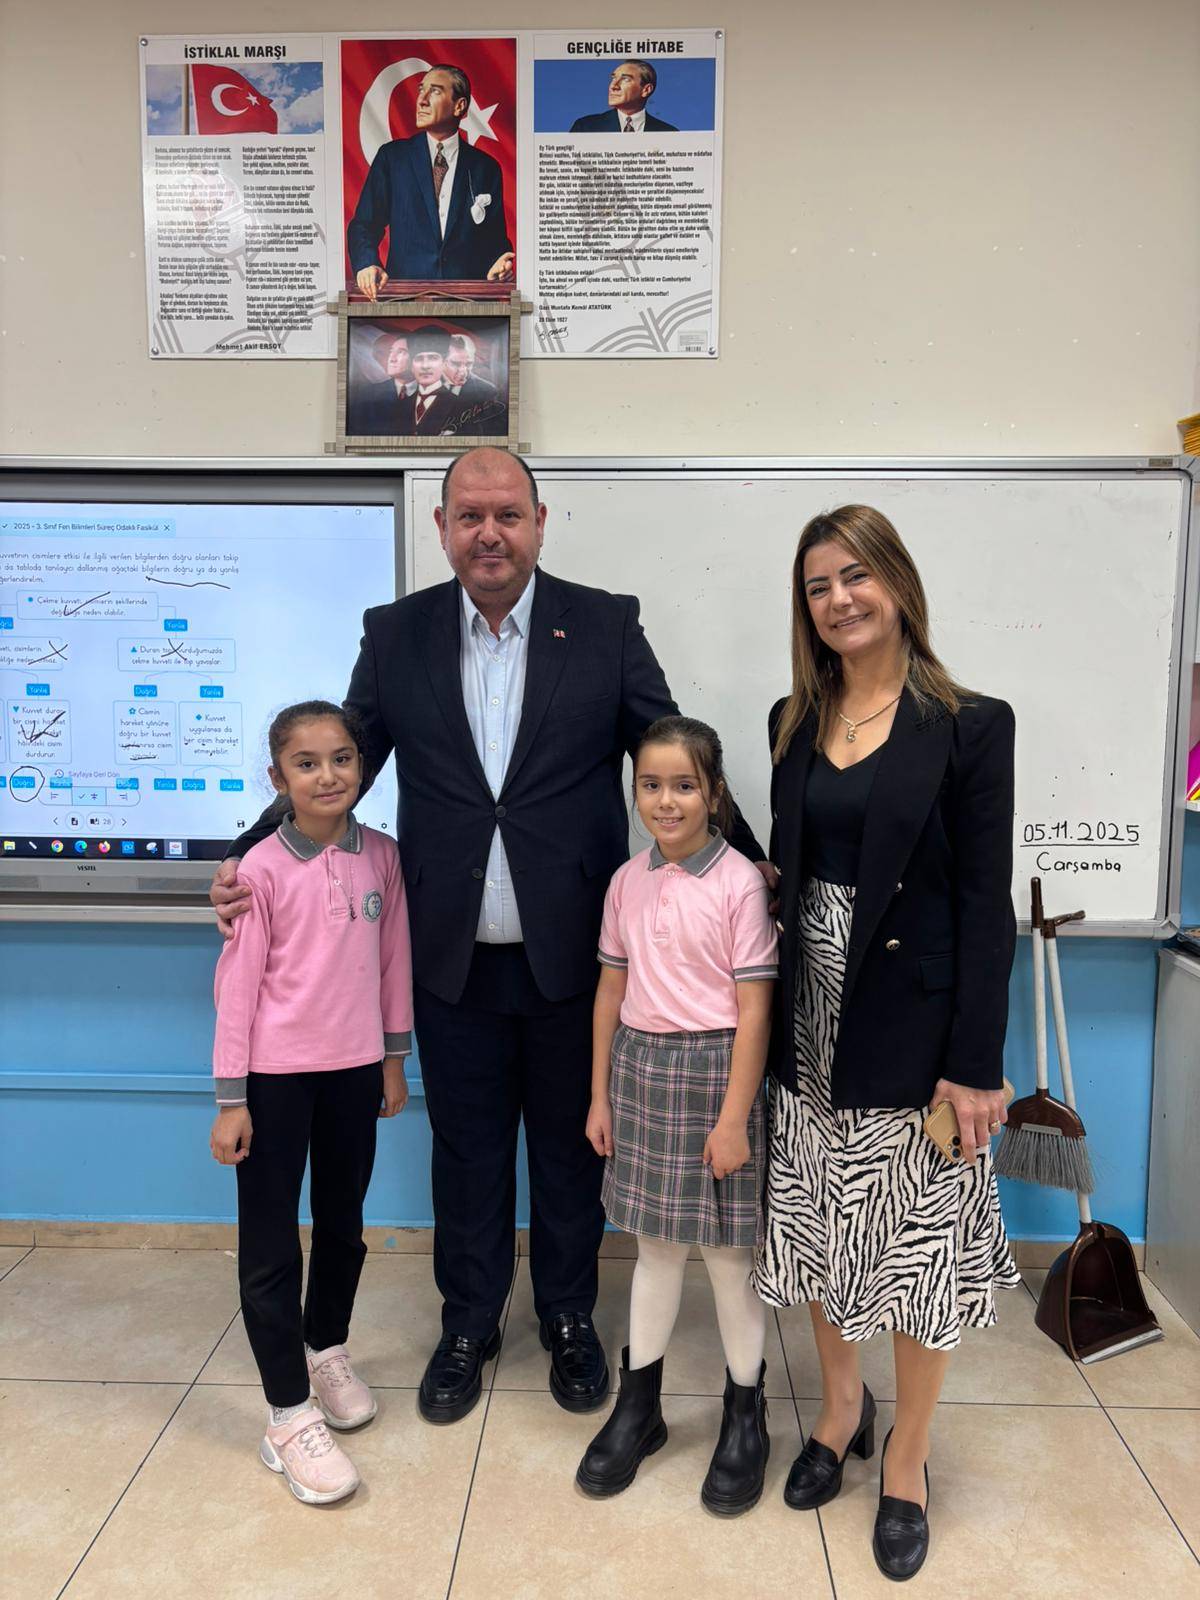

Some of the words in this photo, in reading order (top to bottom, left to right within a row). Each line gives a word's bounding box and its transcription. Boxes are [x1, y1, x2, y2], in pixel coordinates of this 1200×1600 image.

[184, 44, 240, 59] İSTİKLAL
[244, 45, 287, 60] MARŞI
[567, 38, 632, 57] GENÇLİĞE
[636, 38, 684, 53] HİTABE
[1023, 820, 1140, 843] 05.11.2025
